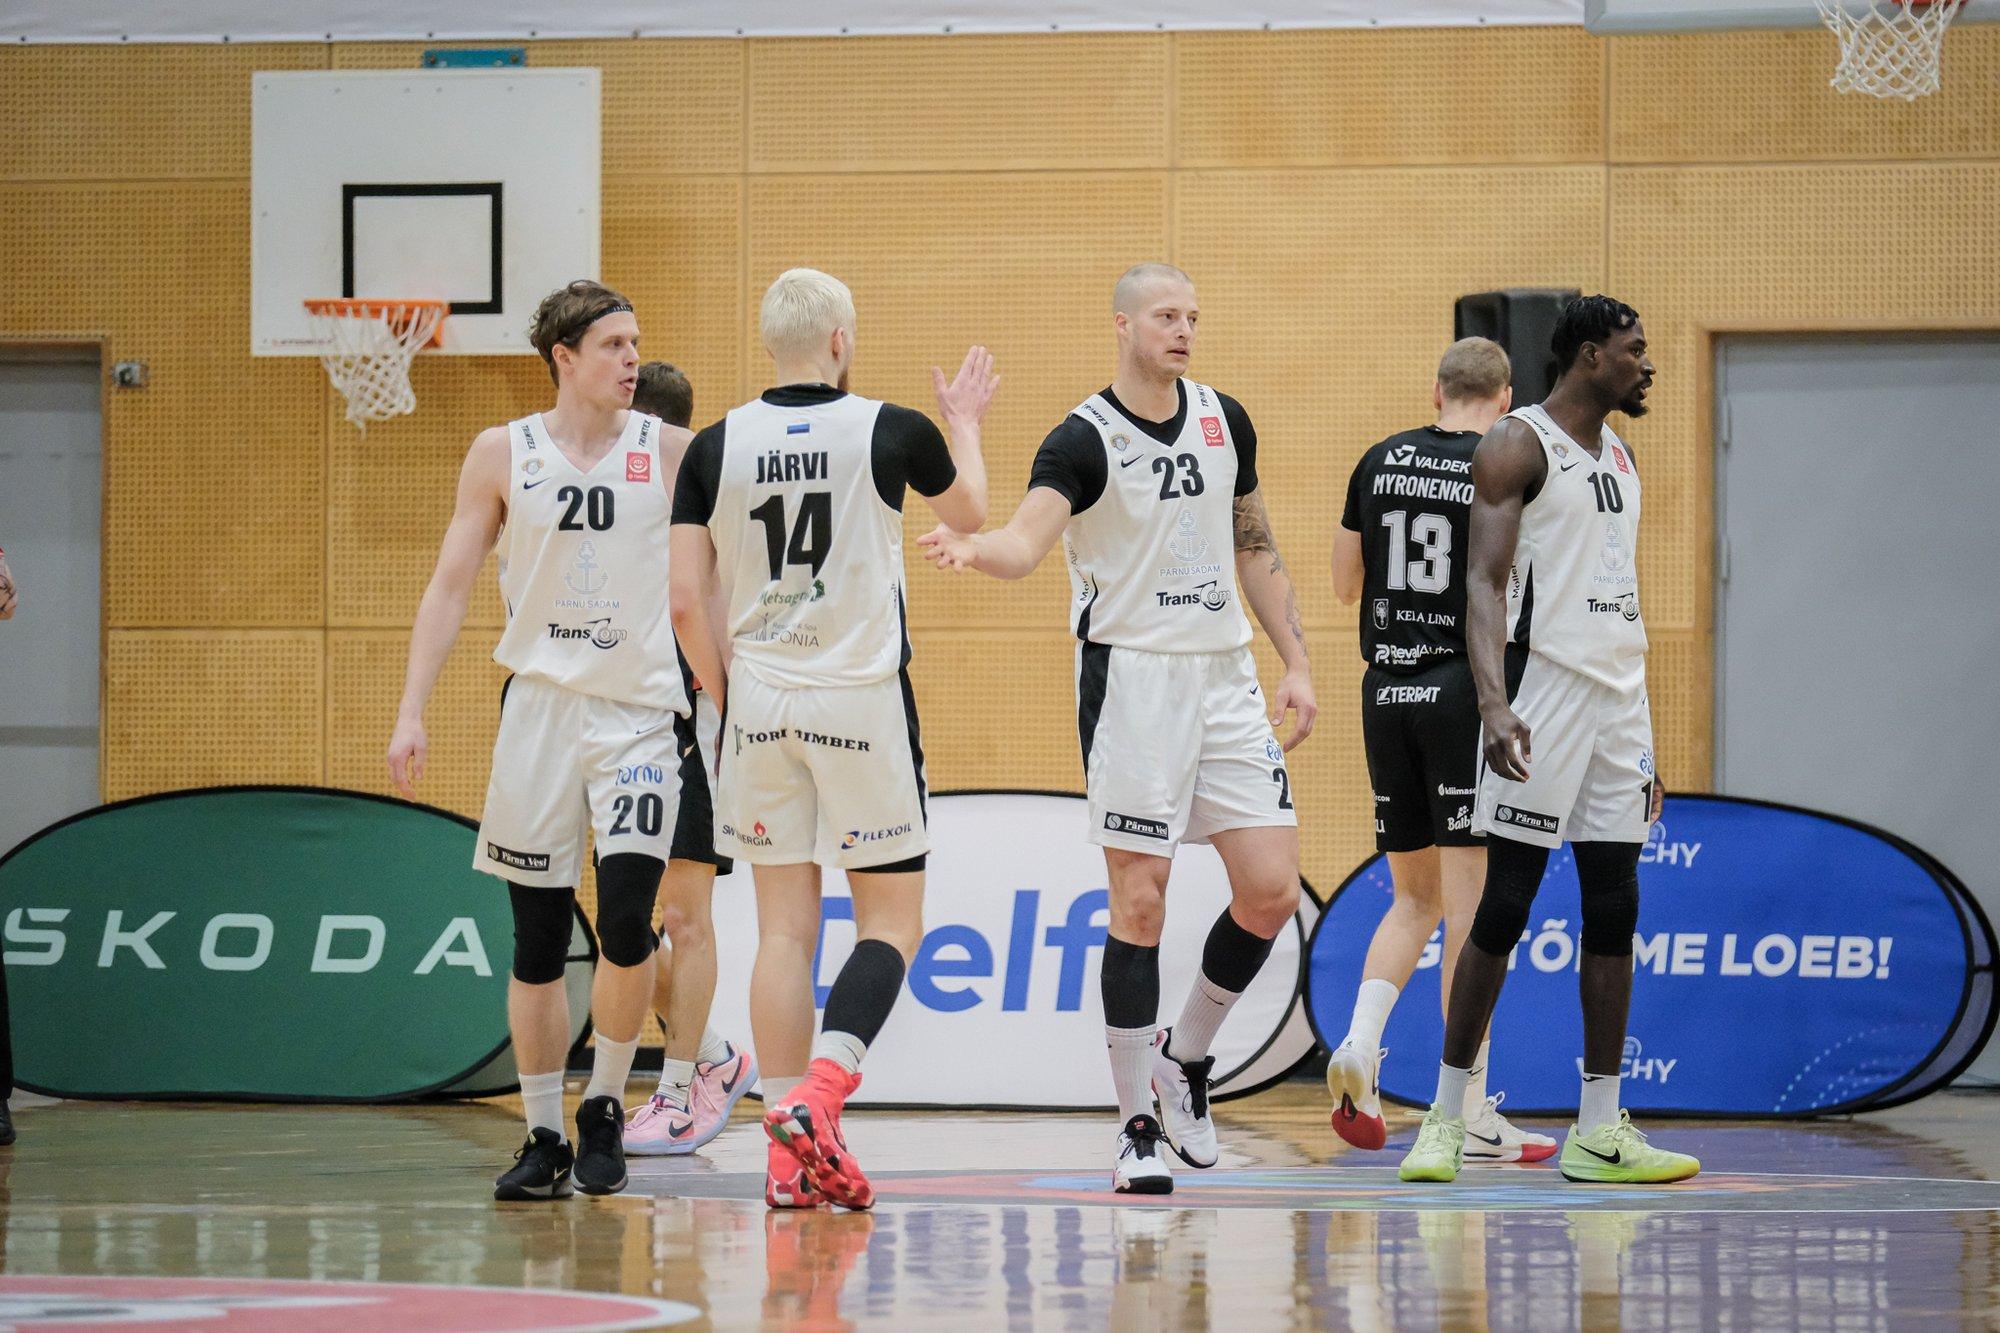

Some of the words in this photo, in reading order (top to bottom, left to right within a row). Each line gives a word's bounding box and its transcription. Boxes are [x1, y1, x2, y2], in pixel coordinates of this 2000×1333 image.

[756, 450, 828, 484] JÄRVI
[1151, 452, 1205, 500] 23
[1373, 473, 1475, 505] MYRONENKO
[1587, 472, 1624, 514] 10
[557, 485, 615, 531] 20
[750, 492, 832, 581] 14
[1381, 510, 1452, 595] 13
[1190, 565, 1221, 575] SADAM
[587, 600, 620, 609] SADAM
[1427, 614, 1456, 627] LINN
[747, 728, 787, 744] TORI
[794, 729, 870, 752] TIMBER
[1272, 768, 1293, 810] 2
[1641, 780, 1652, 823] 1
[608, 793, 664, 837] 20
[1124, 819, 1154, 833] Pärnu
[1515, 812, 1541, 828] Pärnu
[1542, 817, 1557, 830] Vesi
[862, 822, 912, 843] FLEXOIL
[501, 851, 526, 866] Pärnu
[527, 855, 548, 868] Vesi
[1720, 933, 1894, 979] LOEB!
